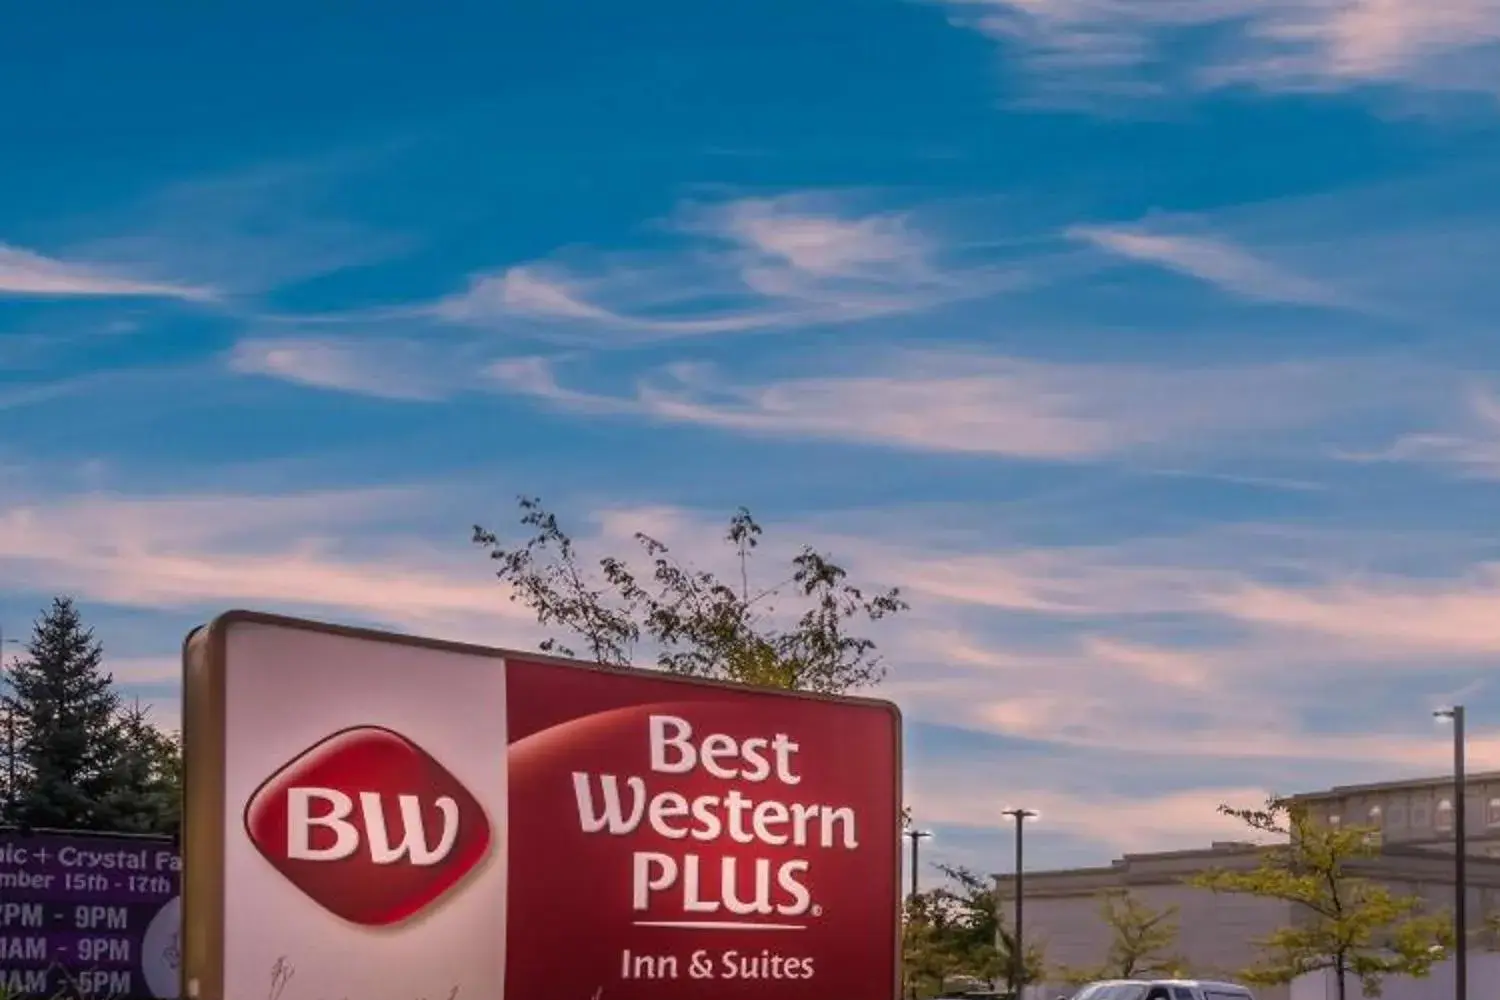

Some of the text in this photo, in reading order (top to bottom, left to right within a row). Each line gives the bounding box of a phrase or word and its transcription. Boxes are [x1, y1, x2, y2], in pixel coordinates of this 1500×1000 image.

[649, 714, 801, 785] Best
[572, 771, 859, 849] Western
[286, 787, 459, 866] BW
[0, 843, 28, 865] ic
[58, 846, 146, 870] Crystal
[65, 873, 108, 891] 15th
[129, 875, 171, 893] 17th
[0, 903, 43, 927] PM
[75, 905, 127, 929] 9PM
[78, 938, 129, 961] 9PM
[621, 949, 815, 979] Inn & Suites
